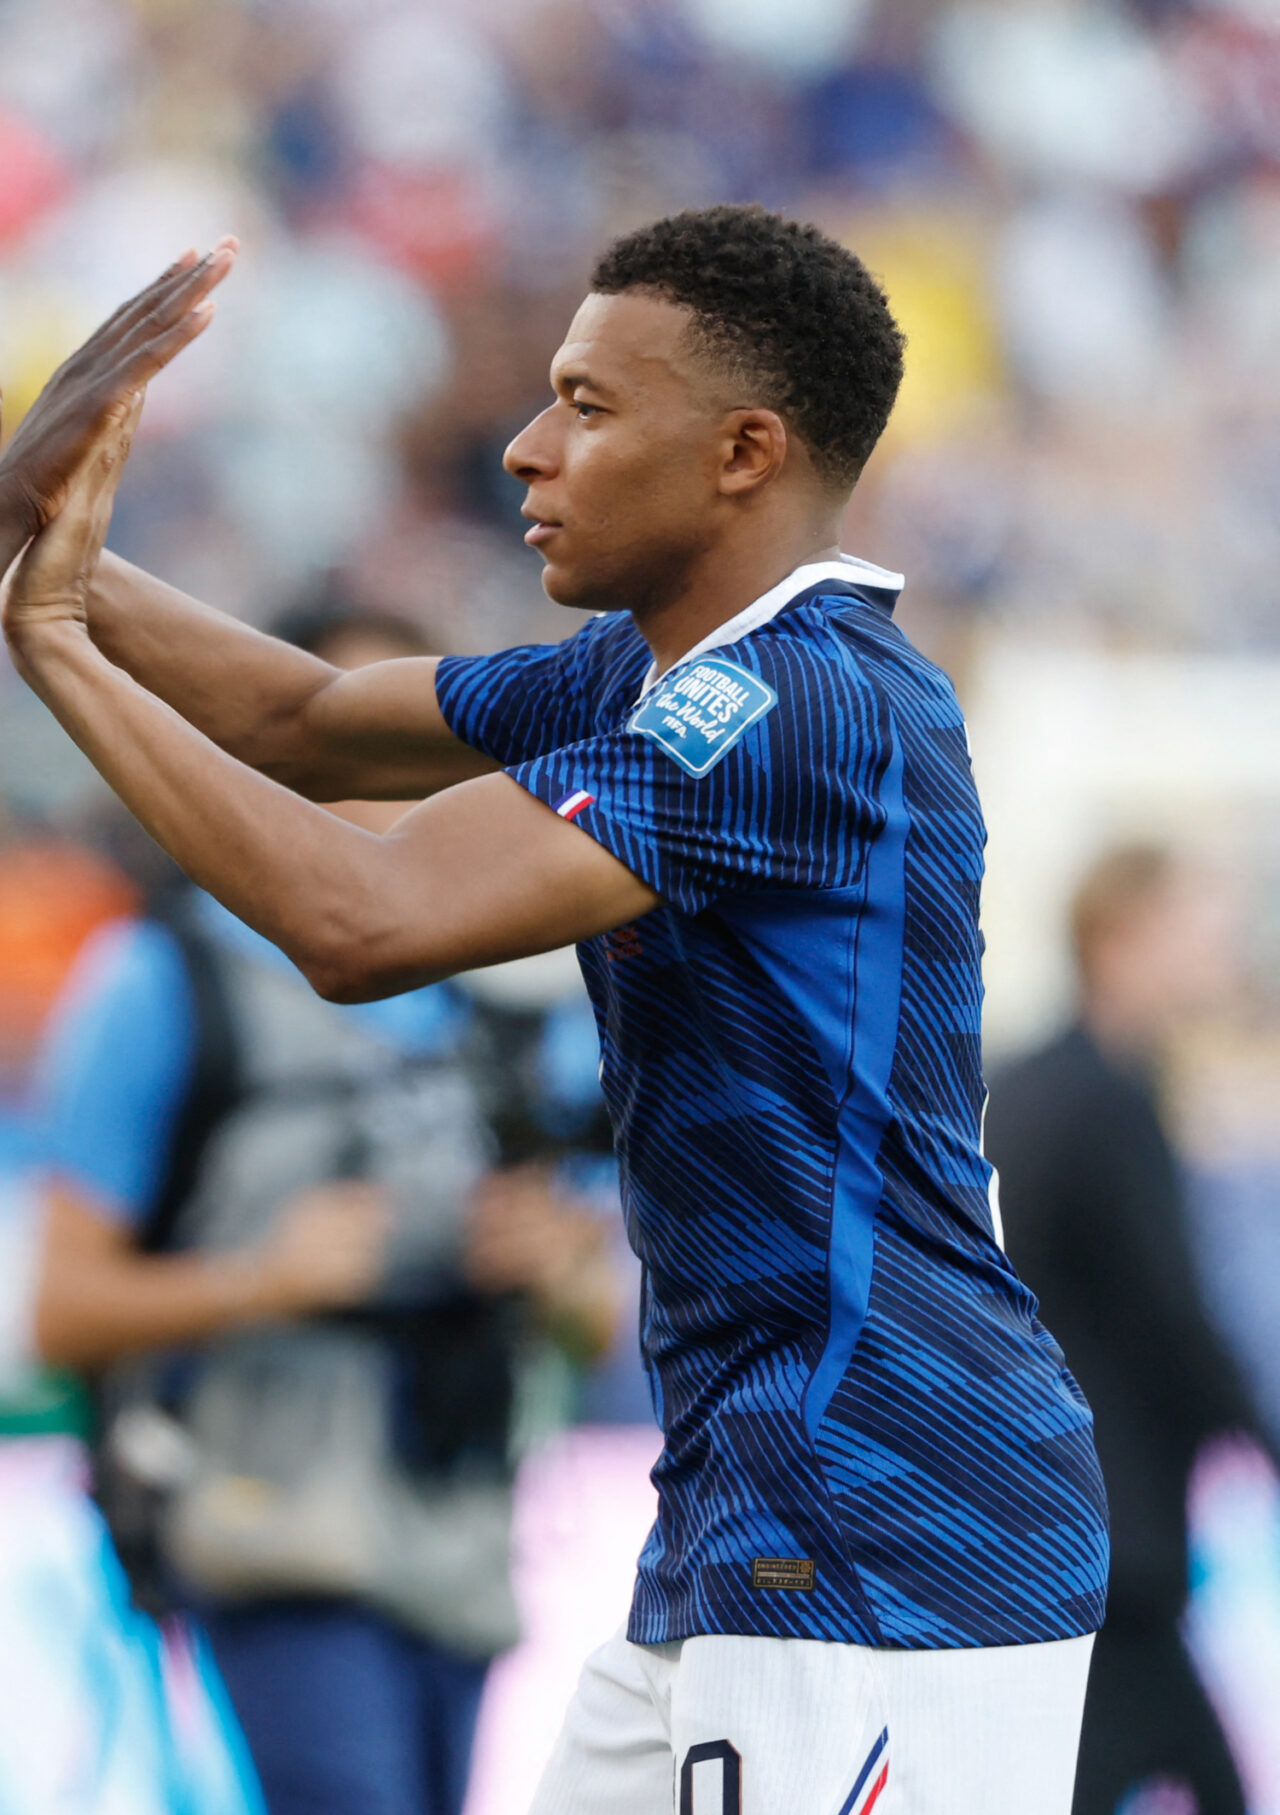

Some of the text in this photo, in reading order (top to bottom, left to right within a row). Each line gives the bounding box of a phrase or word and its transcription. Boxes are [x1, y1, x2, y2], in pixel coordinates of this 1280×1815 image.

[673, 675, 739, 724] UNITES
[689, 665, 750, 707] FOOTBALL
[656, 692, 726, 744] the World
[662, 715, 688, 739] FIFA
